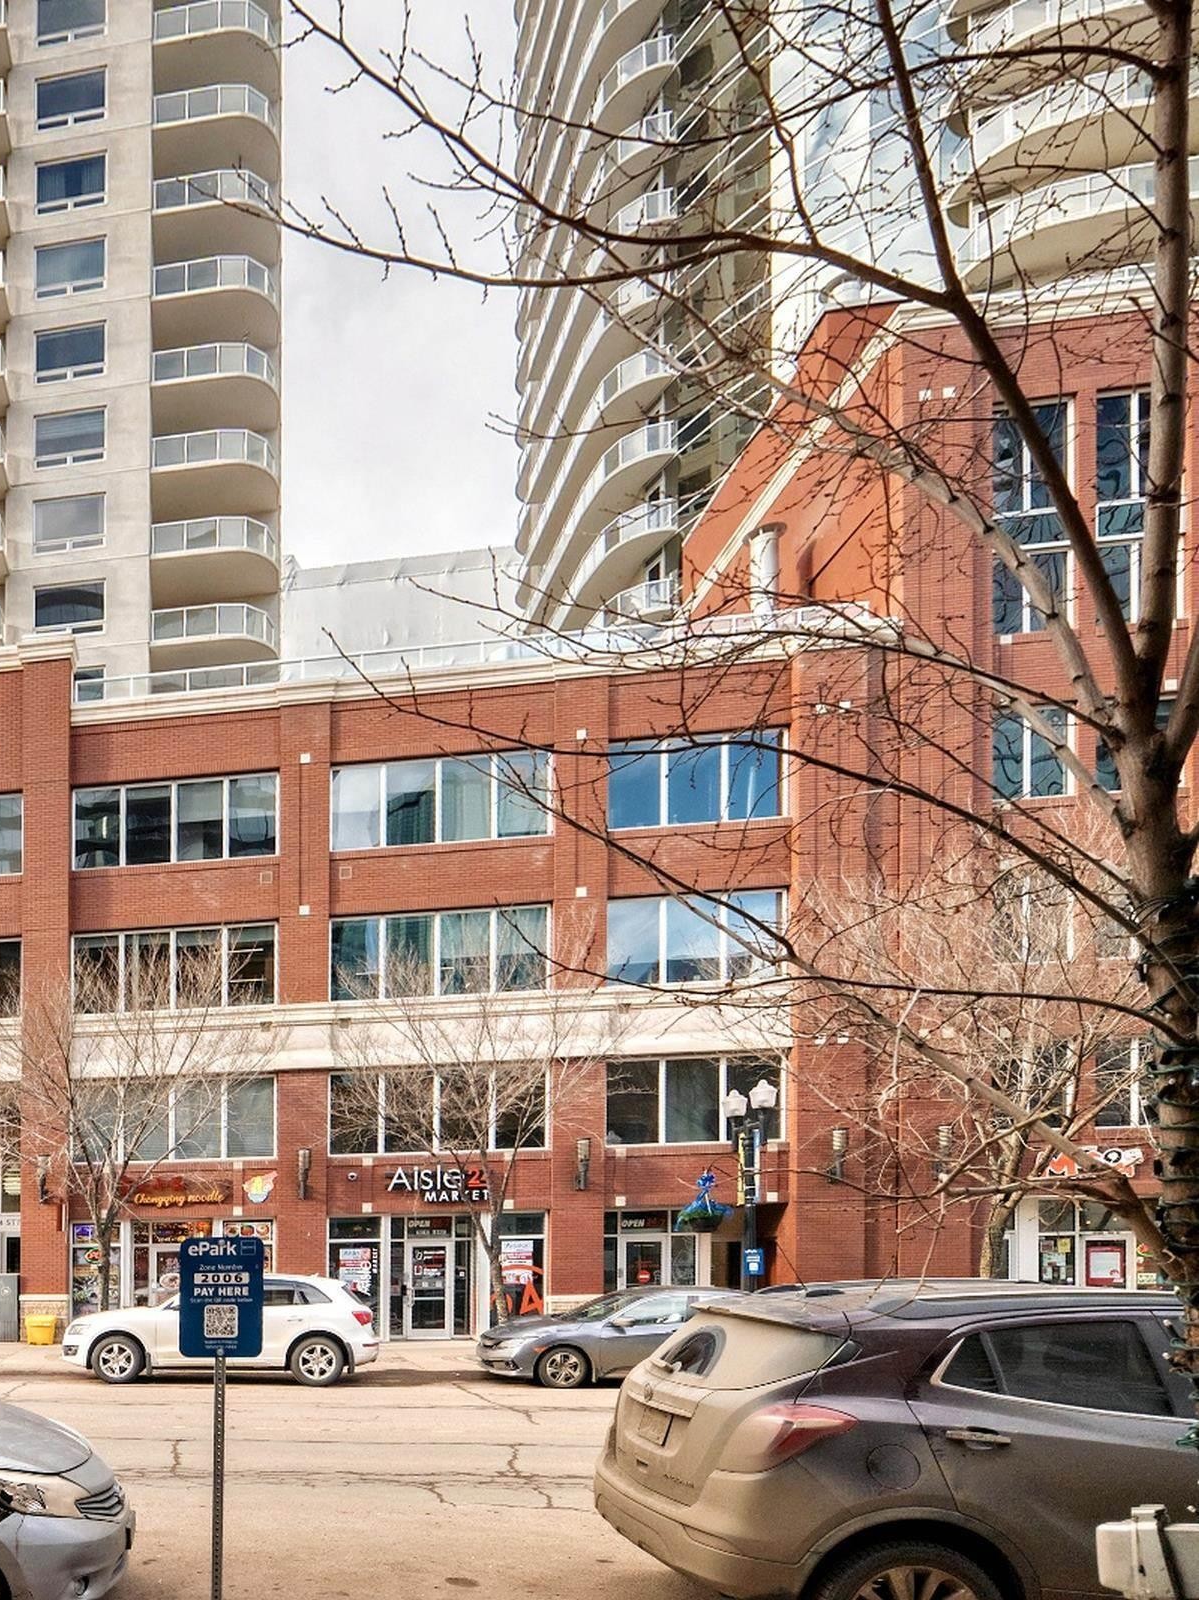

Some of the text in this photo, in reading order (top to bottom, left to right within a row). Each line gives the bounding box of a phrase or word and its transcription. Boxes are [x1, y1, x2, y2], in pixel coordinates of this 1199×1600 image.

[387, 1165, 463, 1191] Aisle
[621, 1218, 645, 1228] OPEN
[187, 1240, 238, 1257] ePark
[201, 1273, 244, 1283] 2006
[194, 1286, 249, 1296] PAY HERE
